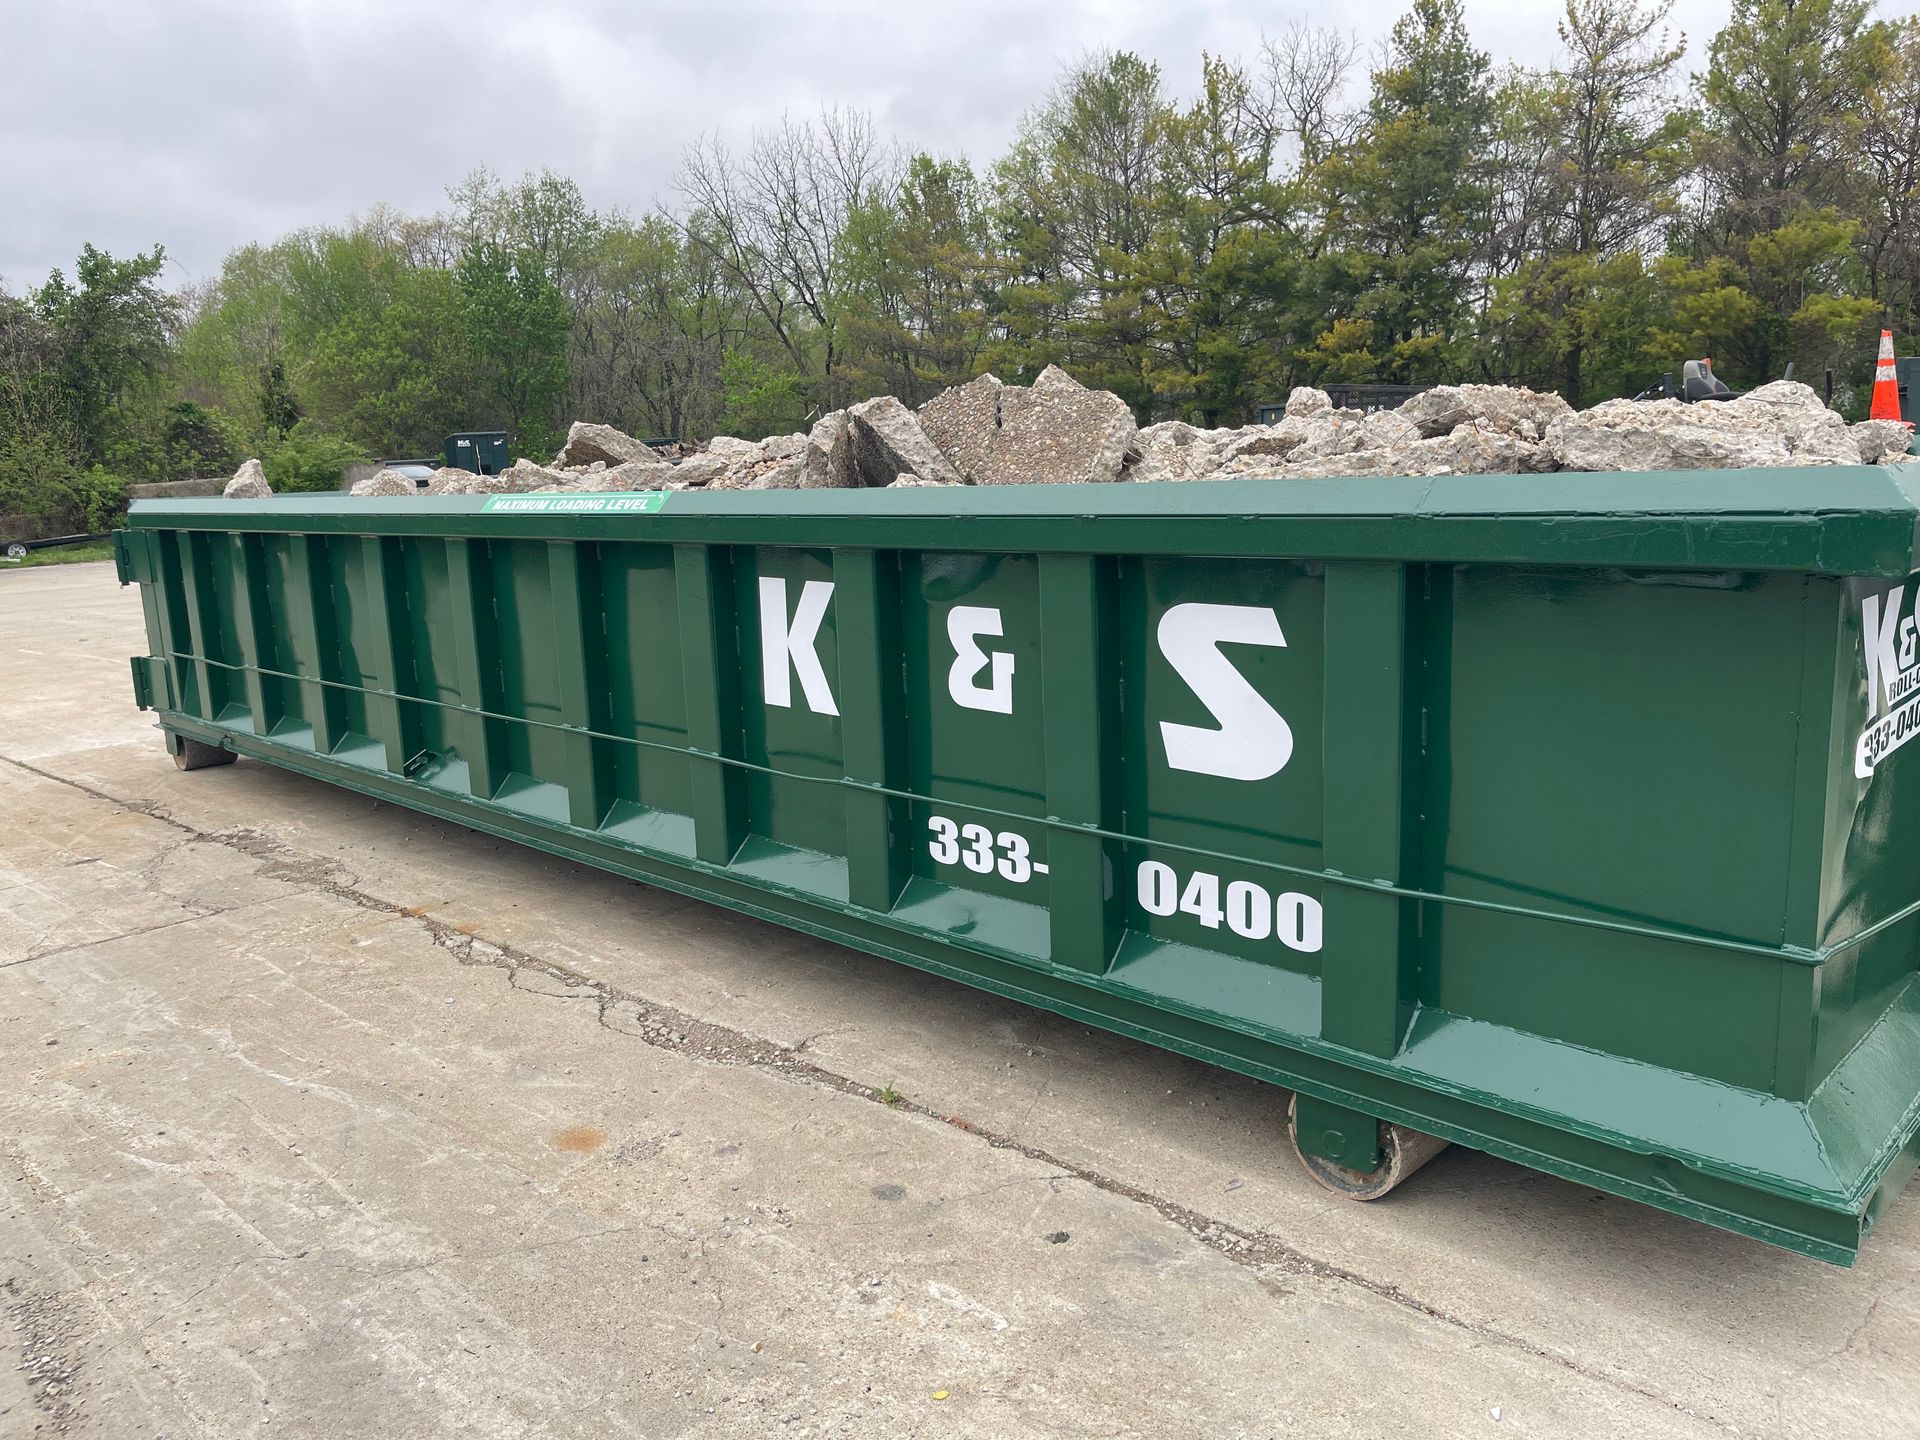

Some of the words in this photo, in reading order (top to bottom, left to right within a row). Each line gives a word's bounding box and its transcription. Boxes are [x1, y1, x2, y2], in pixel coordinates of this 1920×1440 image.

[491, 499, 550, 511] MAXIMUM
[548, 499, 606, 511] LOADING
[605, 499, 649, 510] LEVEL
[758, 576, 840, 717] K
[947, 605, 1015, 715] &
[1157, 602, 1294, 781] S
[1862, 584, 1920, 724] K&
[928, 816, 1049, 883] 333-
[1137, 860, 1323, 953] 0400
